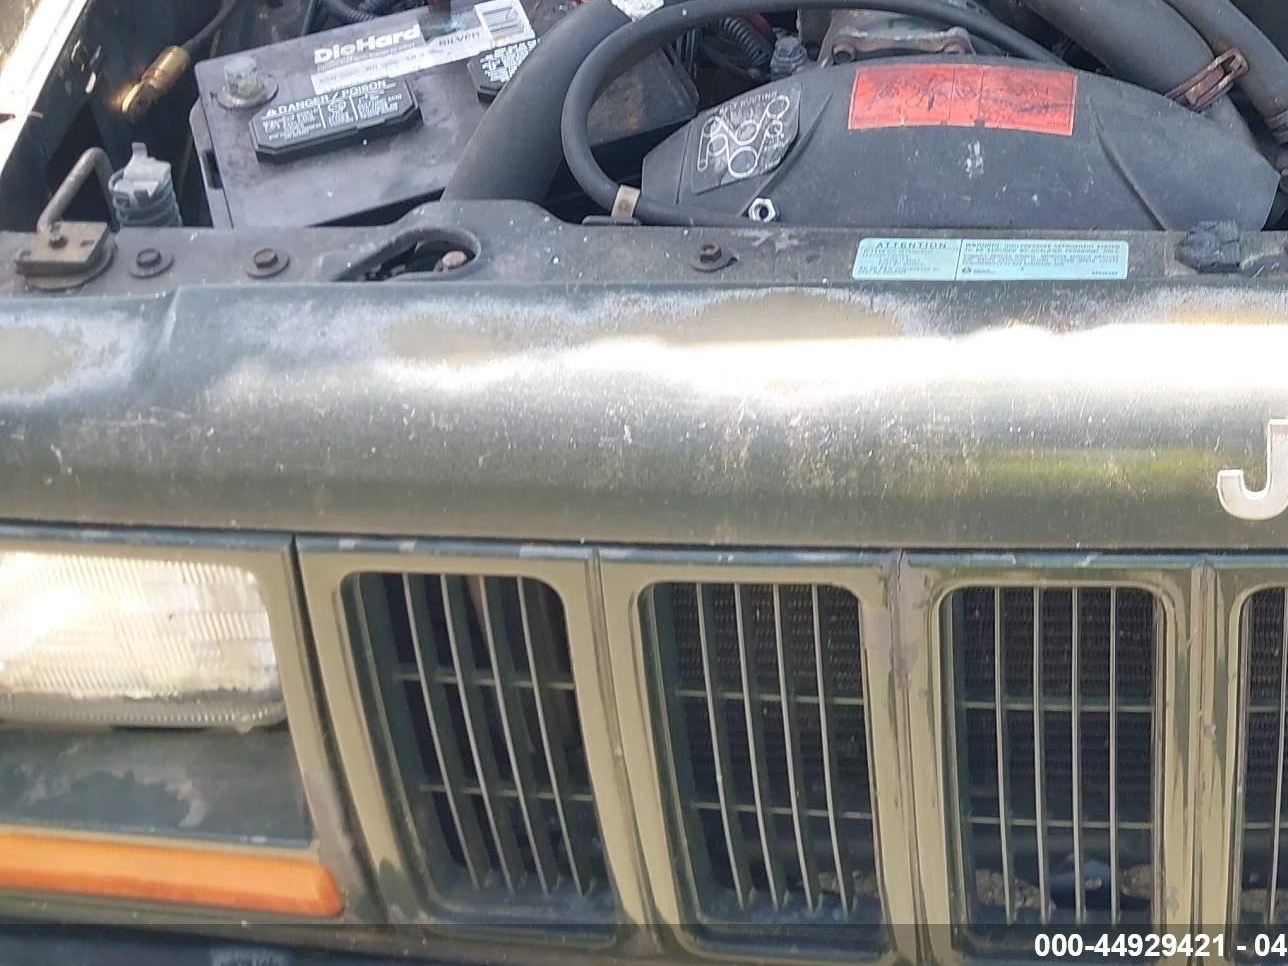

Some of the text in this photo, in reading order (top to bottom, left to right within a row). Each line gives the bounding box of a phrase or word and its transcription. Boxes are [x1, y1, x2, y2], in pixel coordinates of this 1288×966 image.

[314, 23, 421, 64] DieHard
[277, 94, 330, 114] DANGER
[341, 79, 387, 98] POISON
[874, 241, 948, 250] ATTENTION
